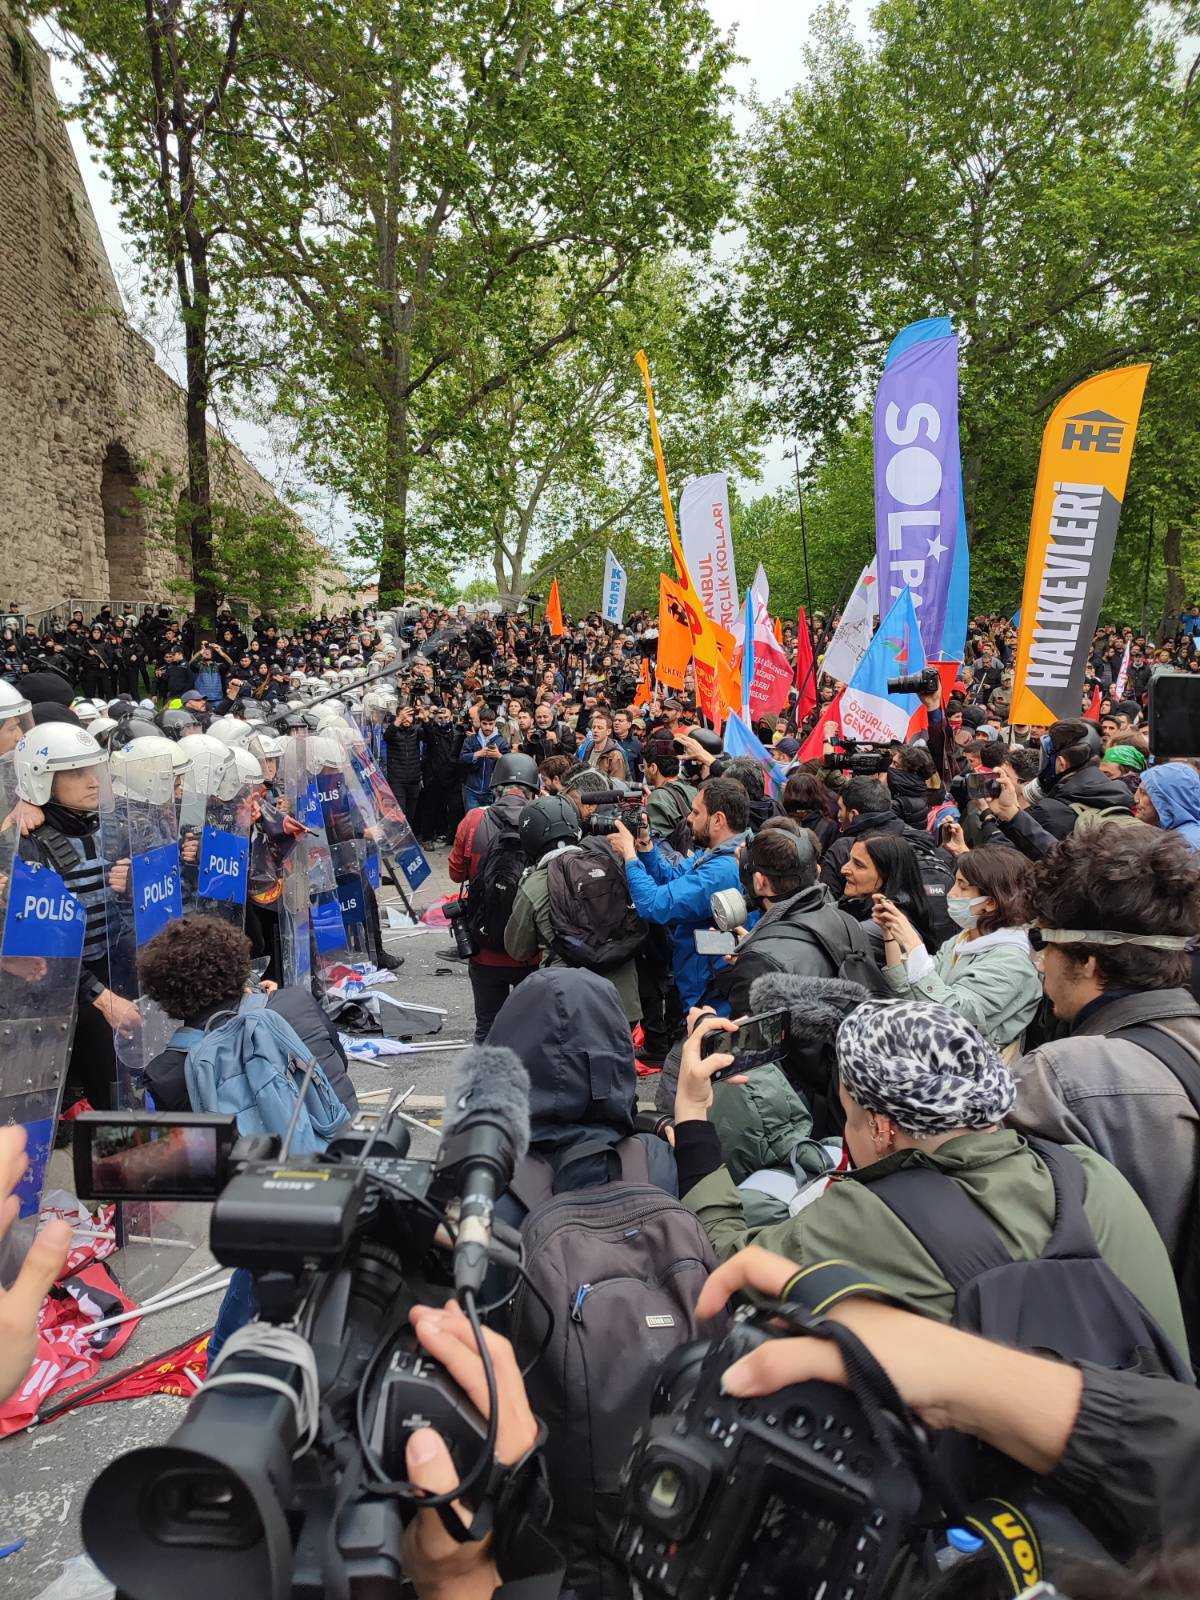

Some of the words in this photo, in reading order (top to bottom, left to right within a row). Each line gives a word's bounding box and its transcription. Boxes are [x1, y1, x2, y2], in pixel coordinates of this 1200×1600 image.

[885, 400, 943, 551] SOL
[711, 502, 728, 572] KOLLARI
[607, 568, 621, 618] KESK
[209, 855, 239, 877] POLİS
[24, 895, 75, 921] POLİS
[144, 875, 174, 907] POLİS
